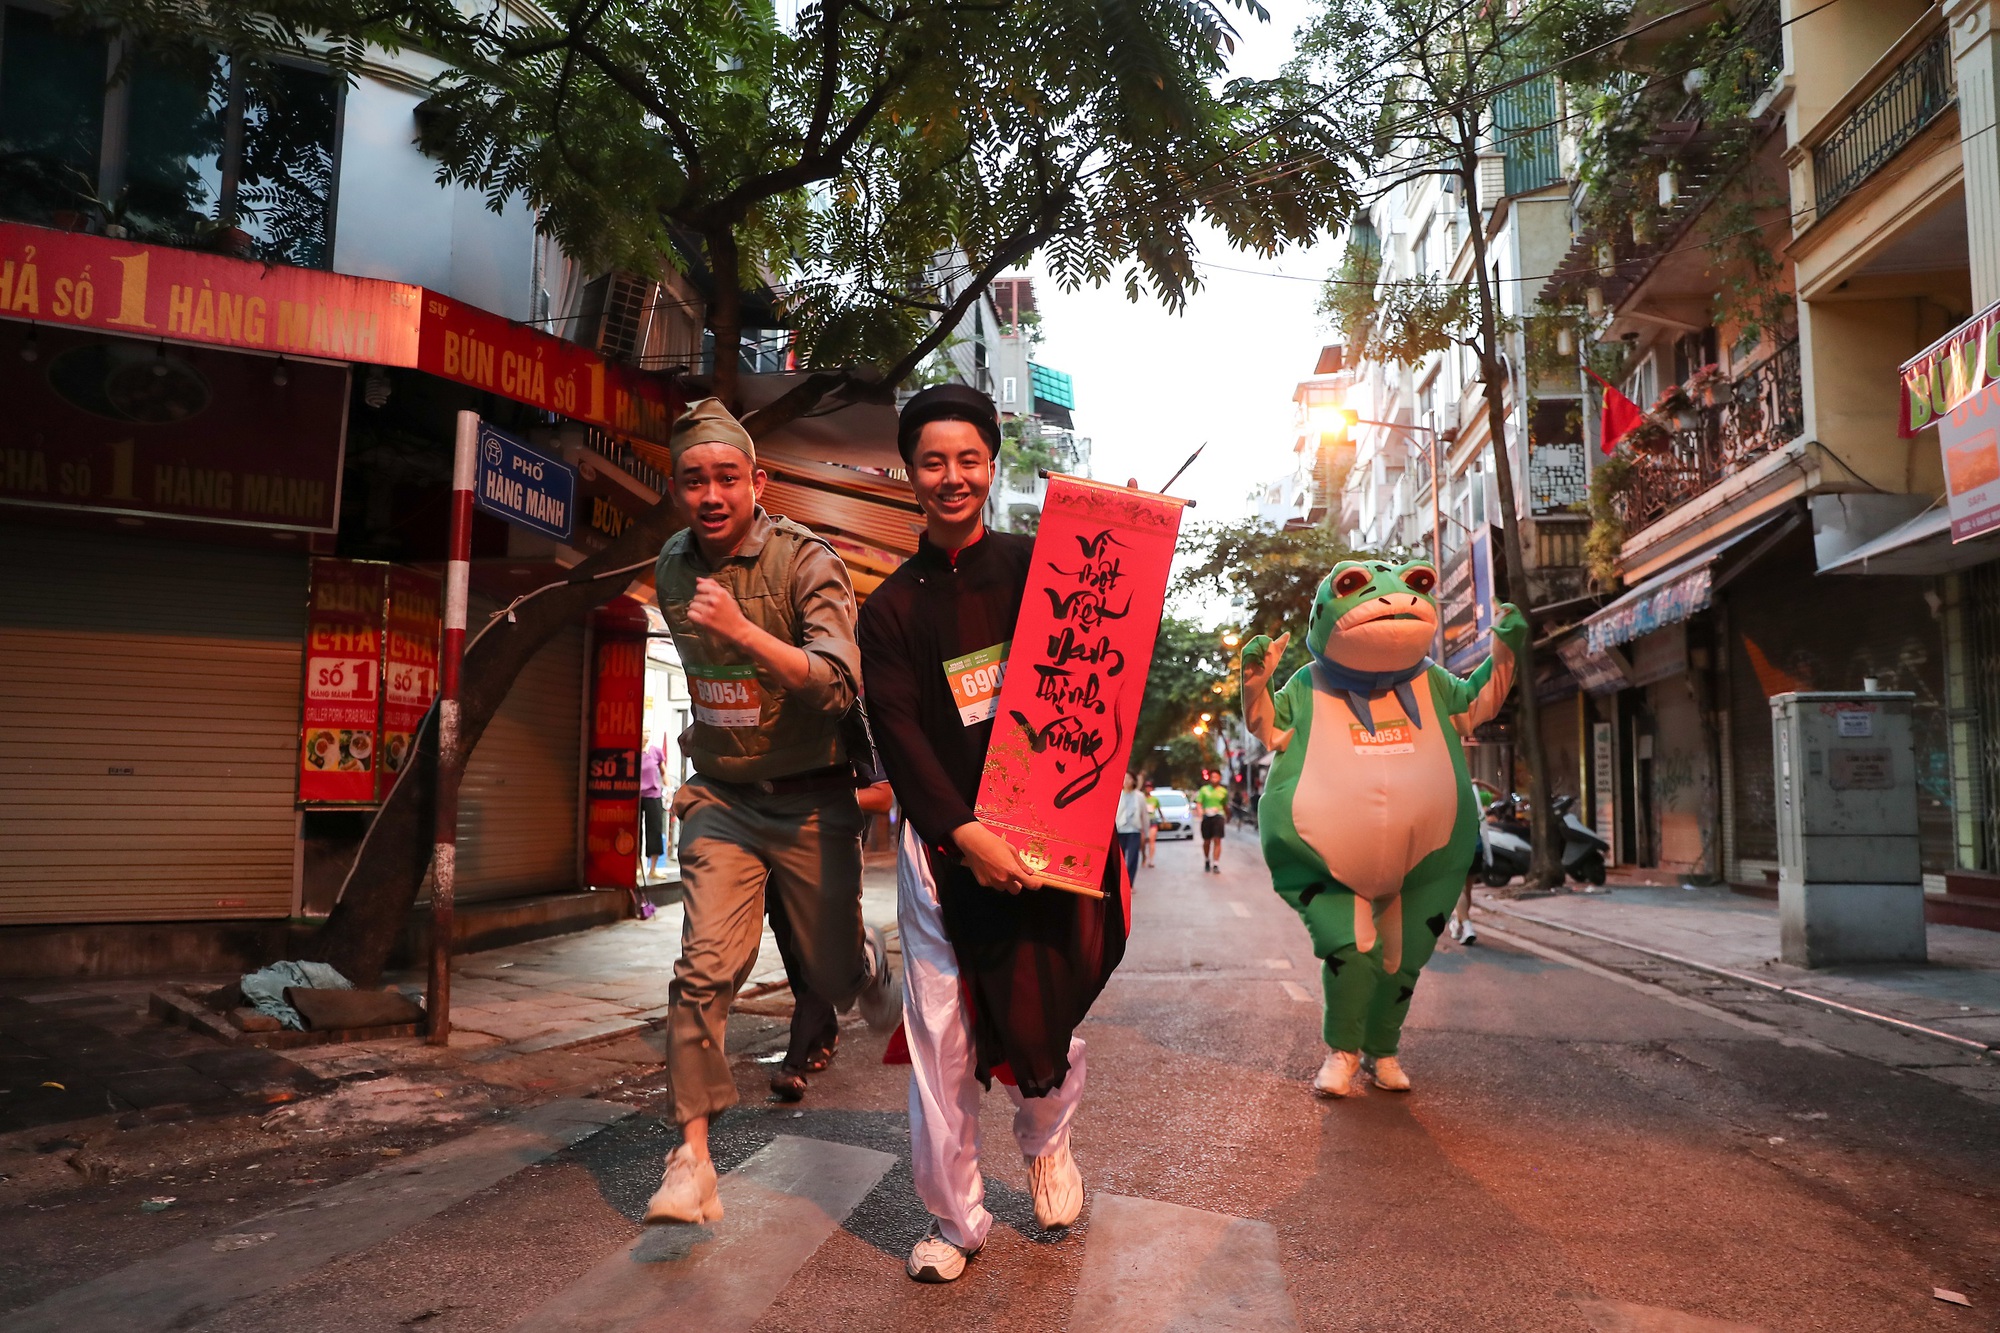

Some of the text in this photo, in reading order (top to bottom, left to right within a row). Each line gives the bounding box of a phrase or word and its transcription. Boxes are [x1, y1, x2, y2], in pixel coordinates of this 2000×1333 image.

[52, 264, 94, 320] SỐ
[105, 250, 157, 329] 1
[168, 278, 266, 345] HÀNG
[276, 296, 380, 357] MÀNH
[428, 300, 449, 320] SỰ
[443, 328, 494, 387] BÚN
[501, 346, 546, 405] CHẢ
[553, 368, 577, 413] SỐ
[584, 361, 610, 424] 1
[60, 453, 92, 496] SỐ
[102, 437, 143, 502] 1
[154, 458, 233, 510] HÀNG
[242, 468, 325, 518] MÀNH
[512, 455, 544, 482] PHỐ
[486, 465, 565, 529] HÀNG MÀNH
[591, 495, 623, 539] BÚN
[1044, 587, 1135, 634] Việt
[310, 689, 330, 698] HÀNG
[319, 661, 373, 699] SỐ 1
[394, 668, 431, 705] SỐ 1
[695, 679, 749, 704] 69054
[596, 690, 637, 735] CHẢ
[590, 750, 636, 778] SỐ 1
